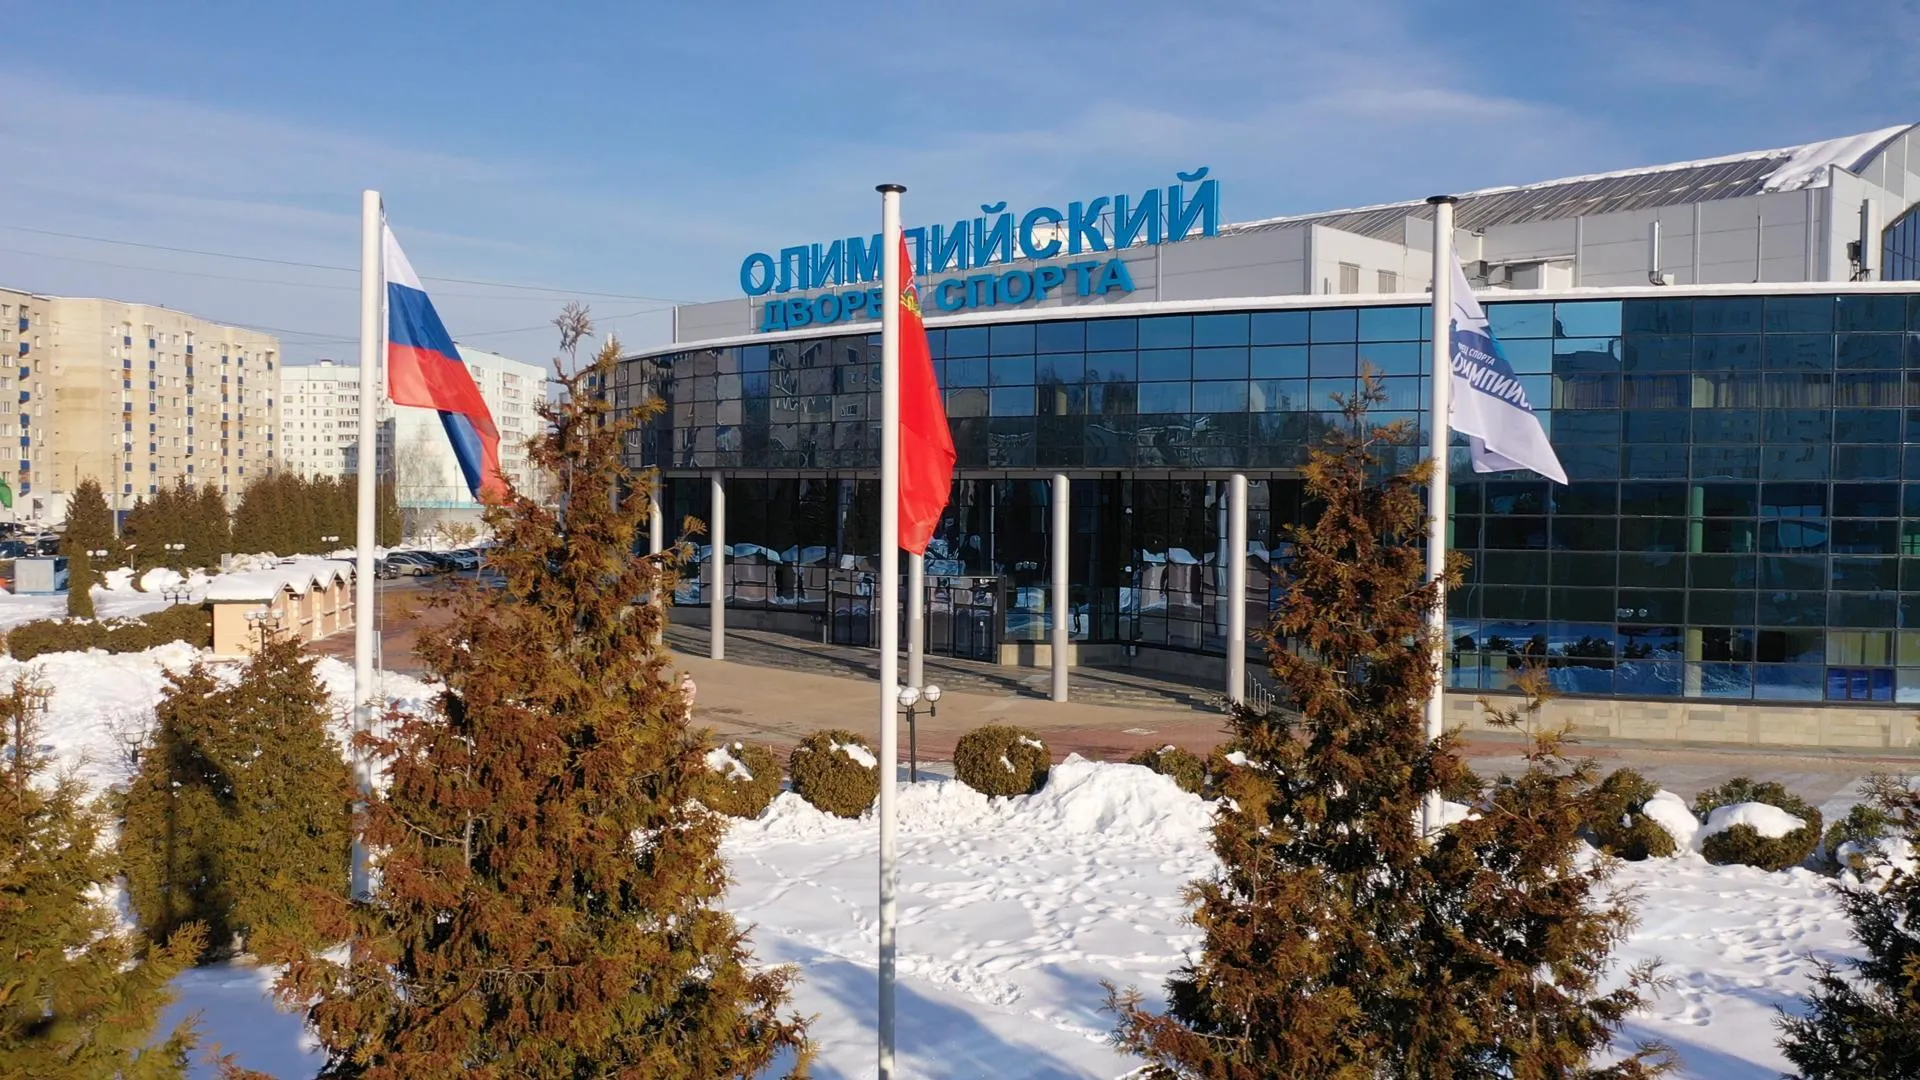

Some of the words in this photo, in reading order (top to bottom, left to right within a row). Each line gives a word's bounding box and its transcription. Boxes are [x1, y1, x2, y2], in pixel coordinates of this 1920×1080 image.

[761, 287, 920, 333] ДВОРЕ
[935, 258, 1136, 312] СПОРТА
[1468, 348, 1496, 366] СПОРТА
